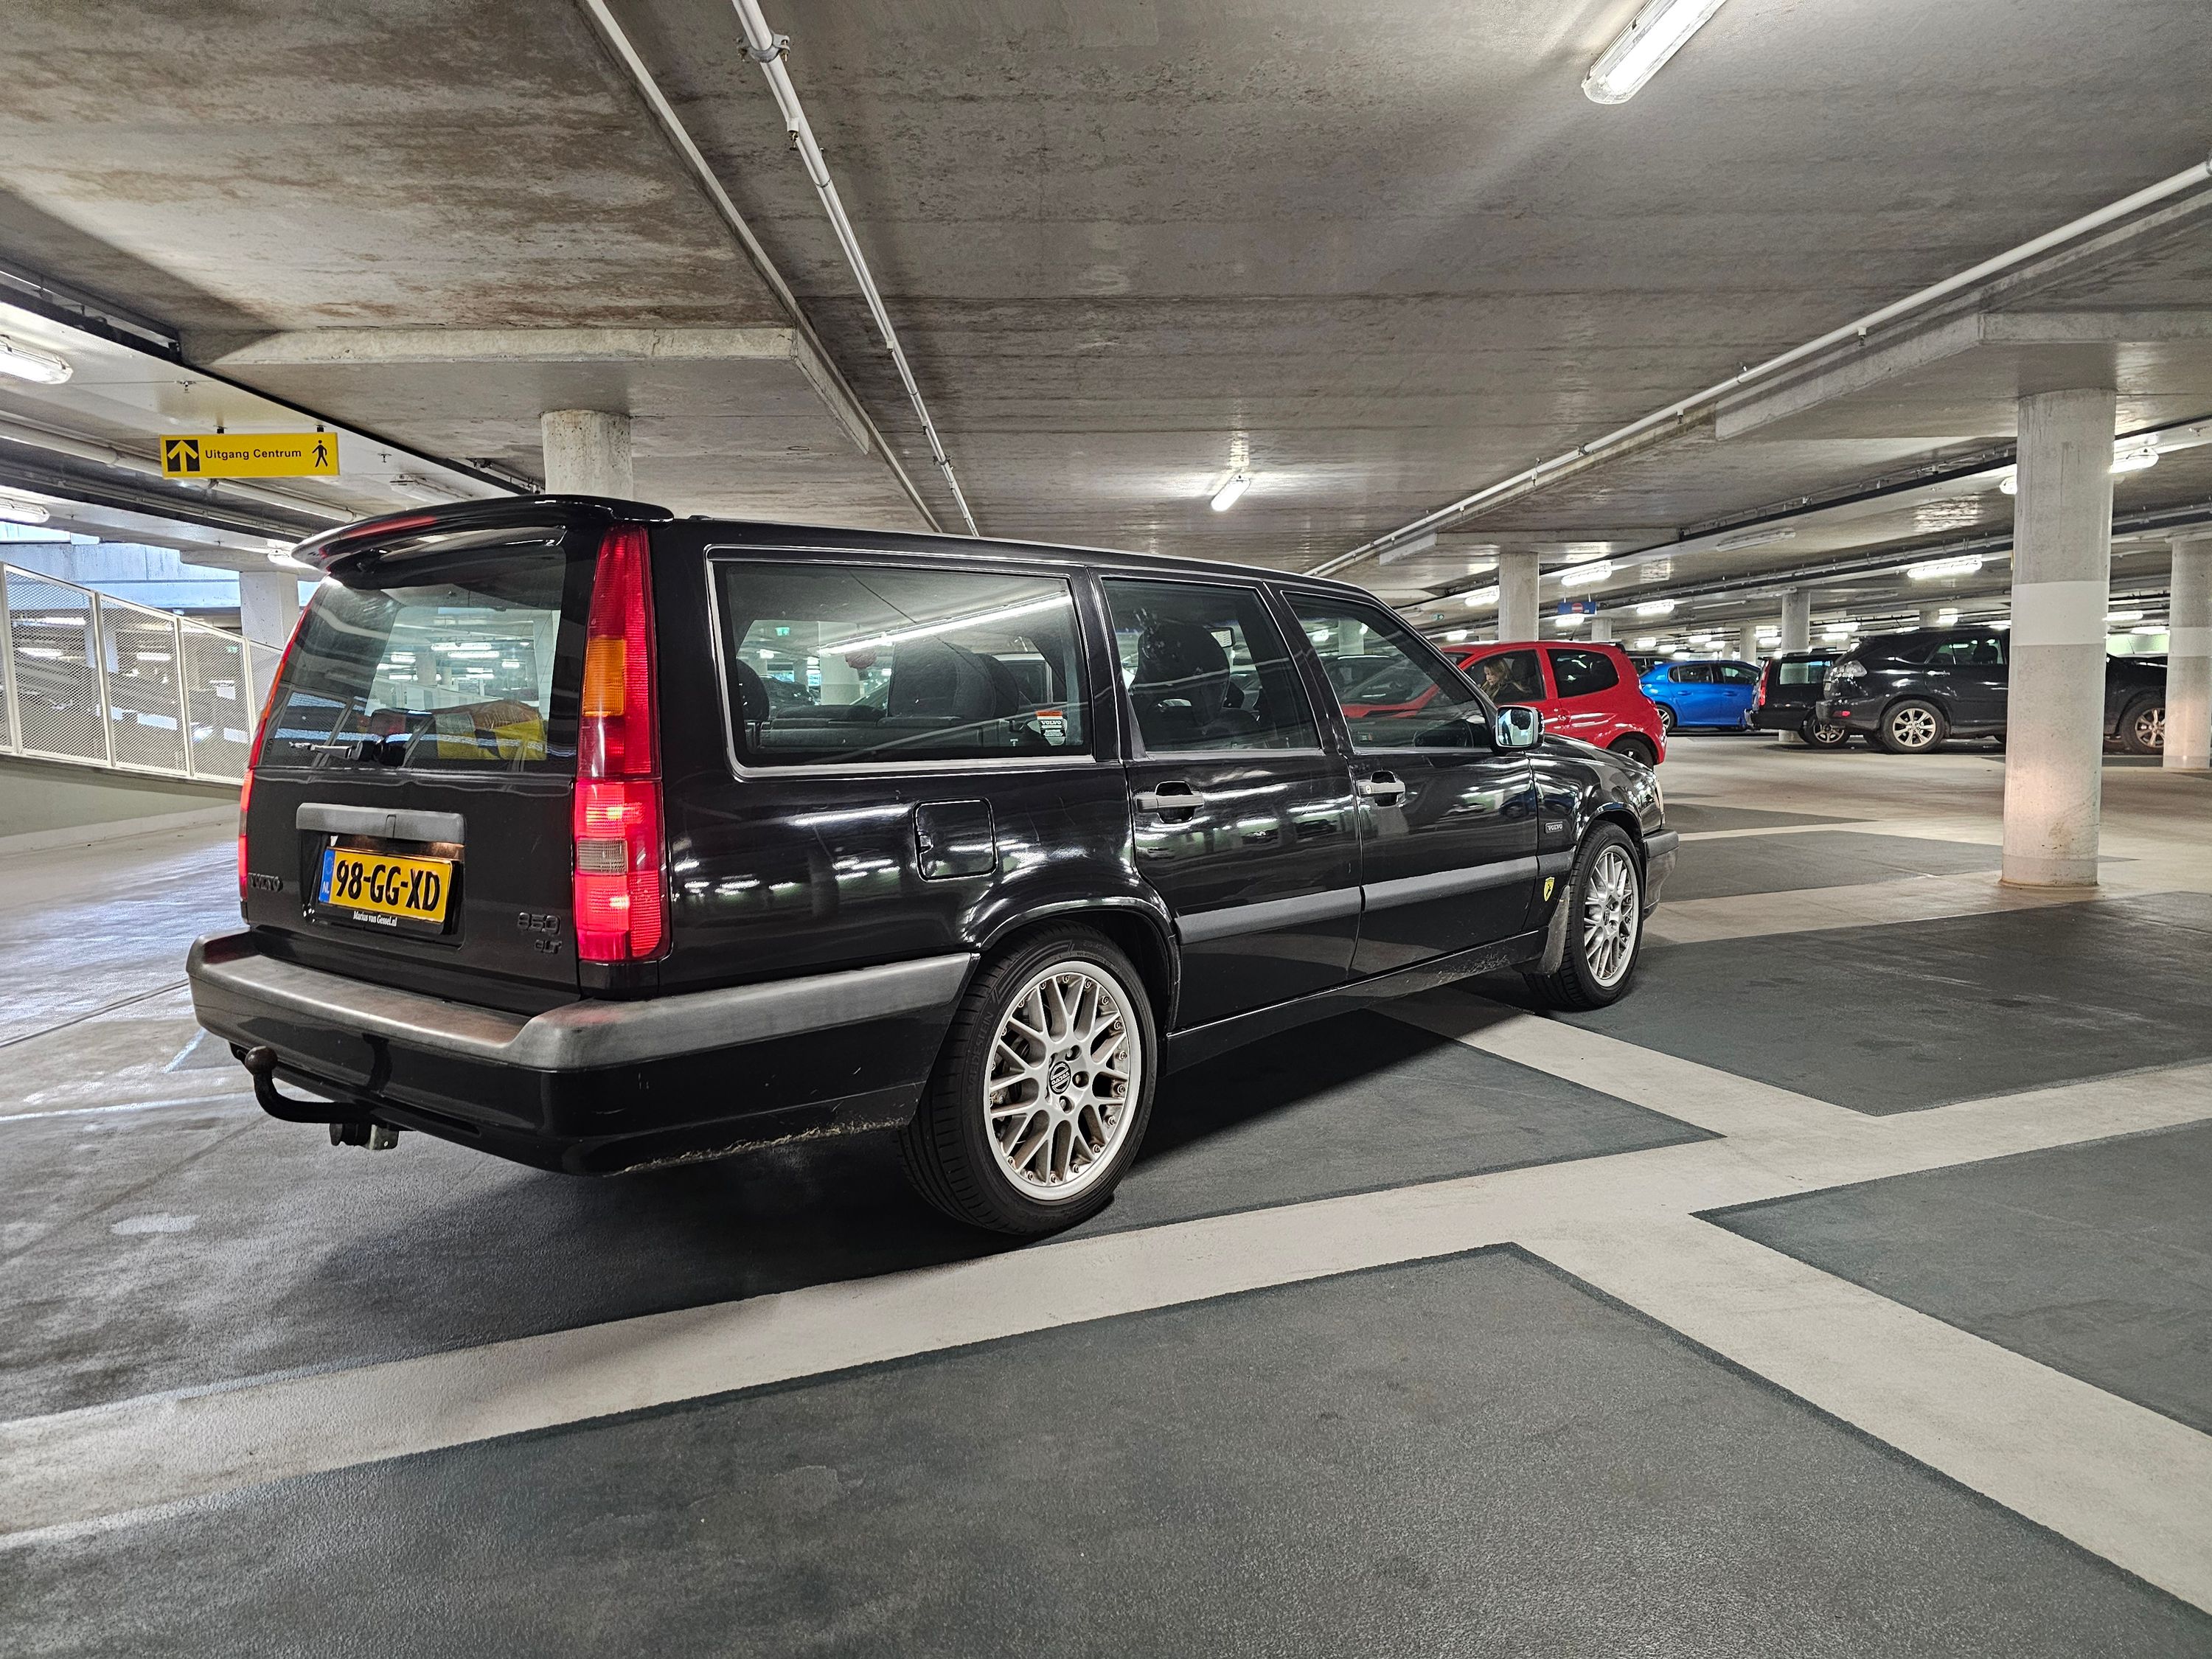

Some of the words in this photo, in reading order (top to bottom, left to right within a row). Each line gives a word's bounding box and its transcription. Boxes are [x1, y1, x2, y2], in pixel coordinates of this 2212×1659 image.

[205, 449, 249, 460] Uitgang
[253, 449, 302, 459] Centrum
[321, 881, 330, 894] NL
[336, 860, 441, 911] 98-GG-XD
[353, 911, 368, 922] Marius
[369, 915, 377, 923] van
[518, 912, 559, 934] 850
[1051, 1071, 1071, 1085] VOLVO
